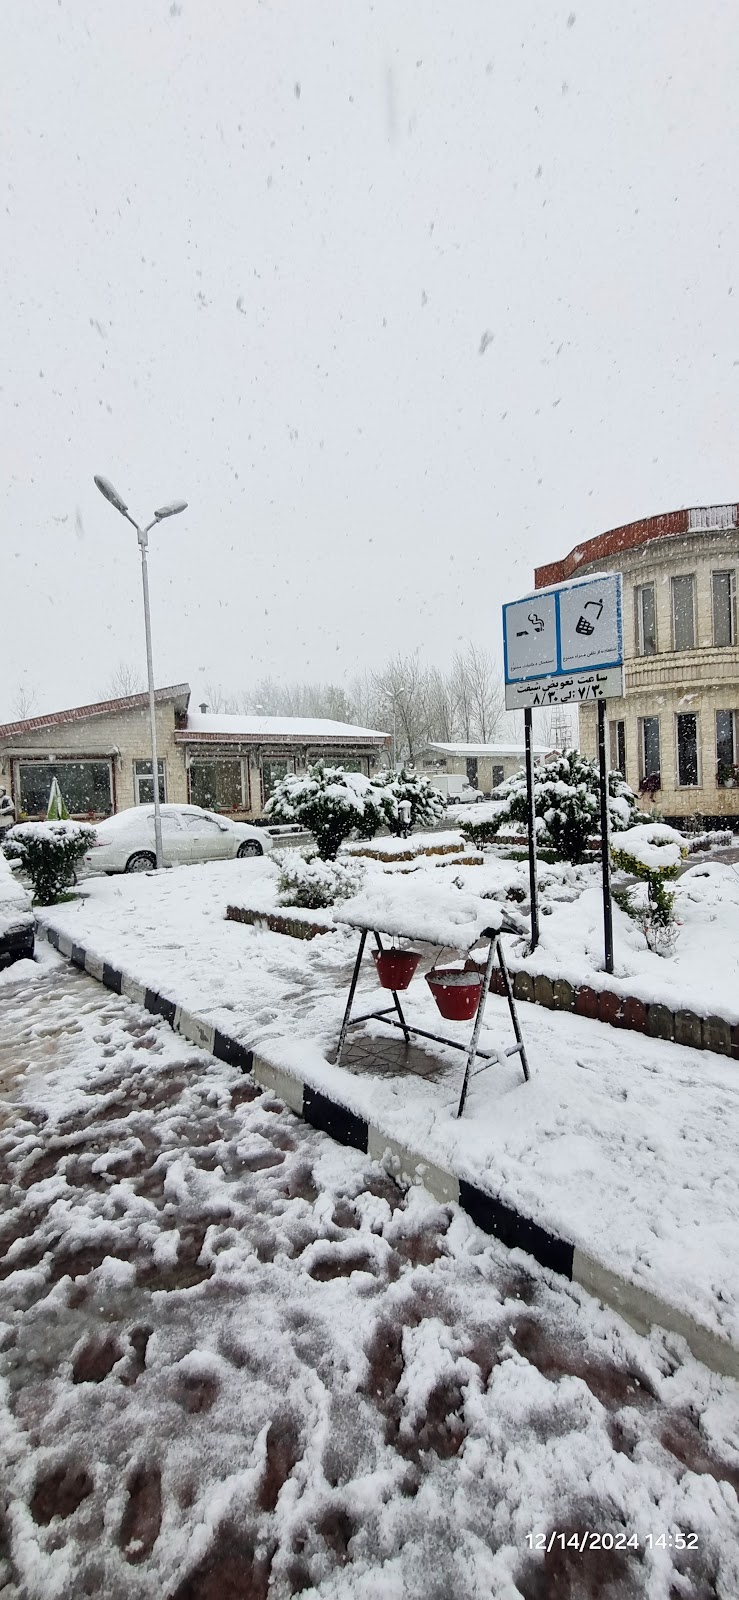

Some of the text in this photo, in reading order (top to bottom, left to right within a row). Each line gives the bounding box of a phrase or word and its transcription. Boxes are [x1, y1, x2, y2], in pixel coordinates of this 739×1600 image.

[516, 673, 608, 695] ساعت تعویض شیفت
